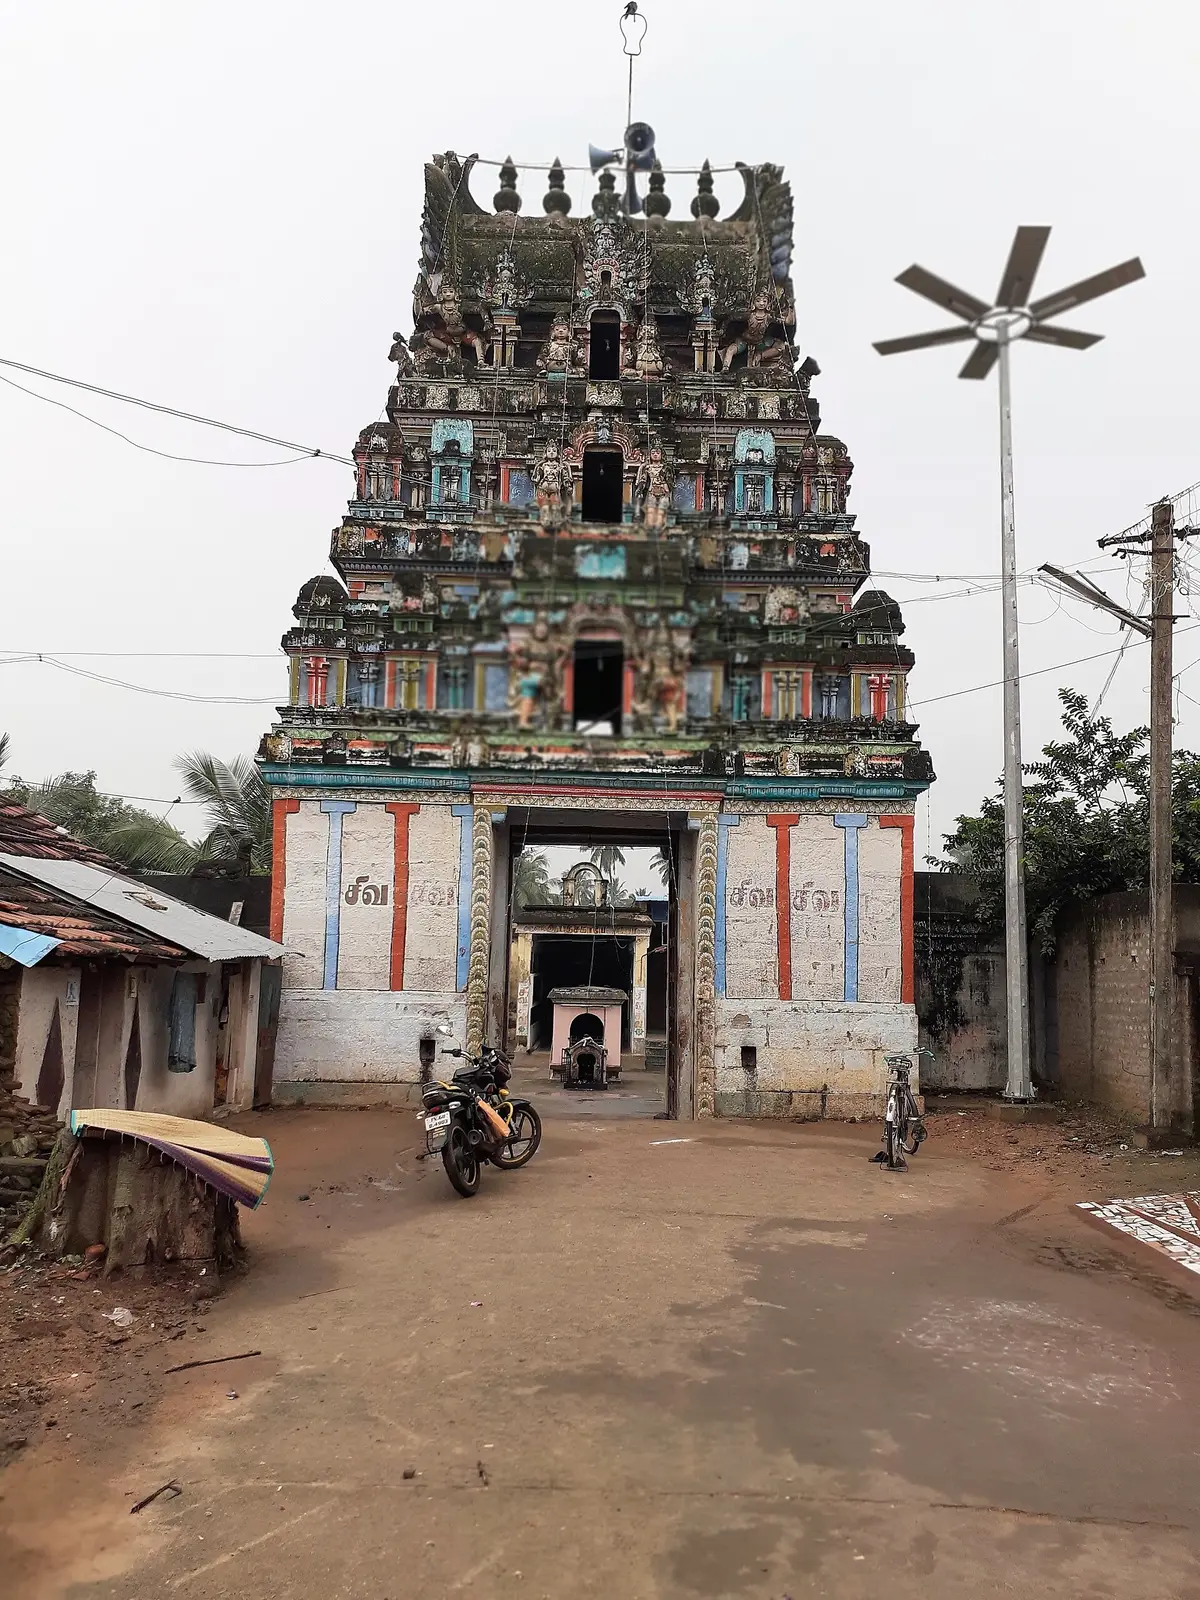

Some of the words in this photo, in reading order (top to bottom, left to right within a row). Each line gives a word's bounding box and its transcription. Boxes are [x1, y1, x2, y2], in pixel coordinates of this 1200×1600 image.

[344, 875, 389, 905] சிவ
[730, 879, 774, 908] சிவ
[792, 881, 839, 912] சிவ
